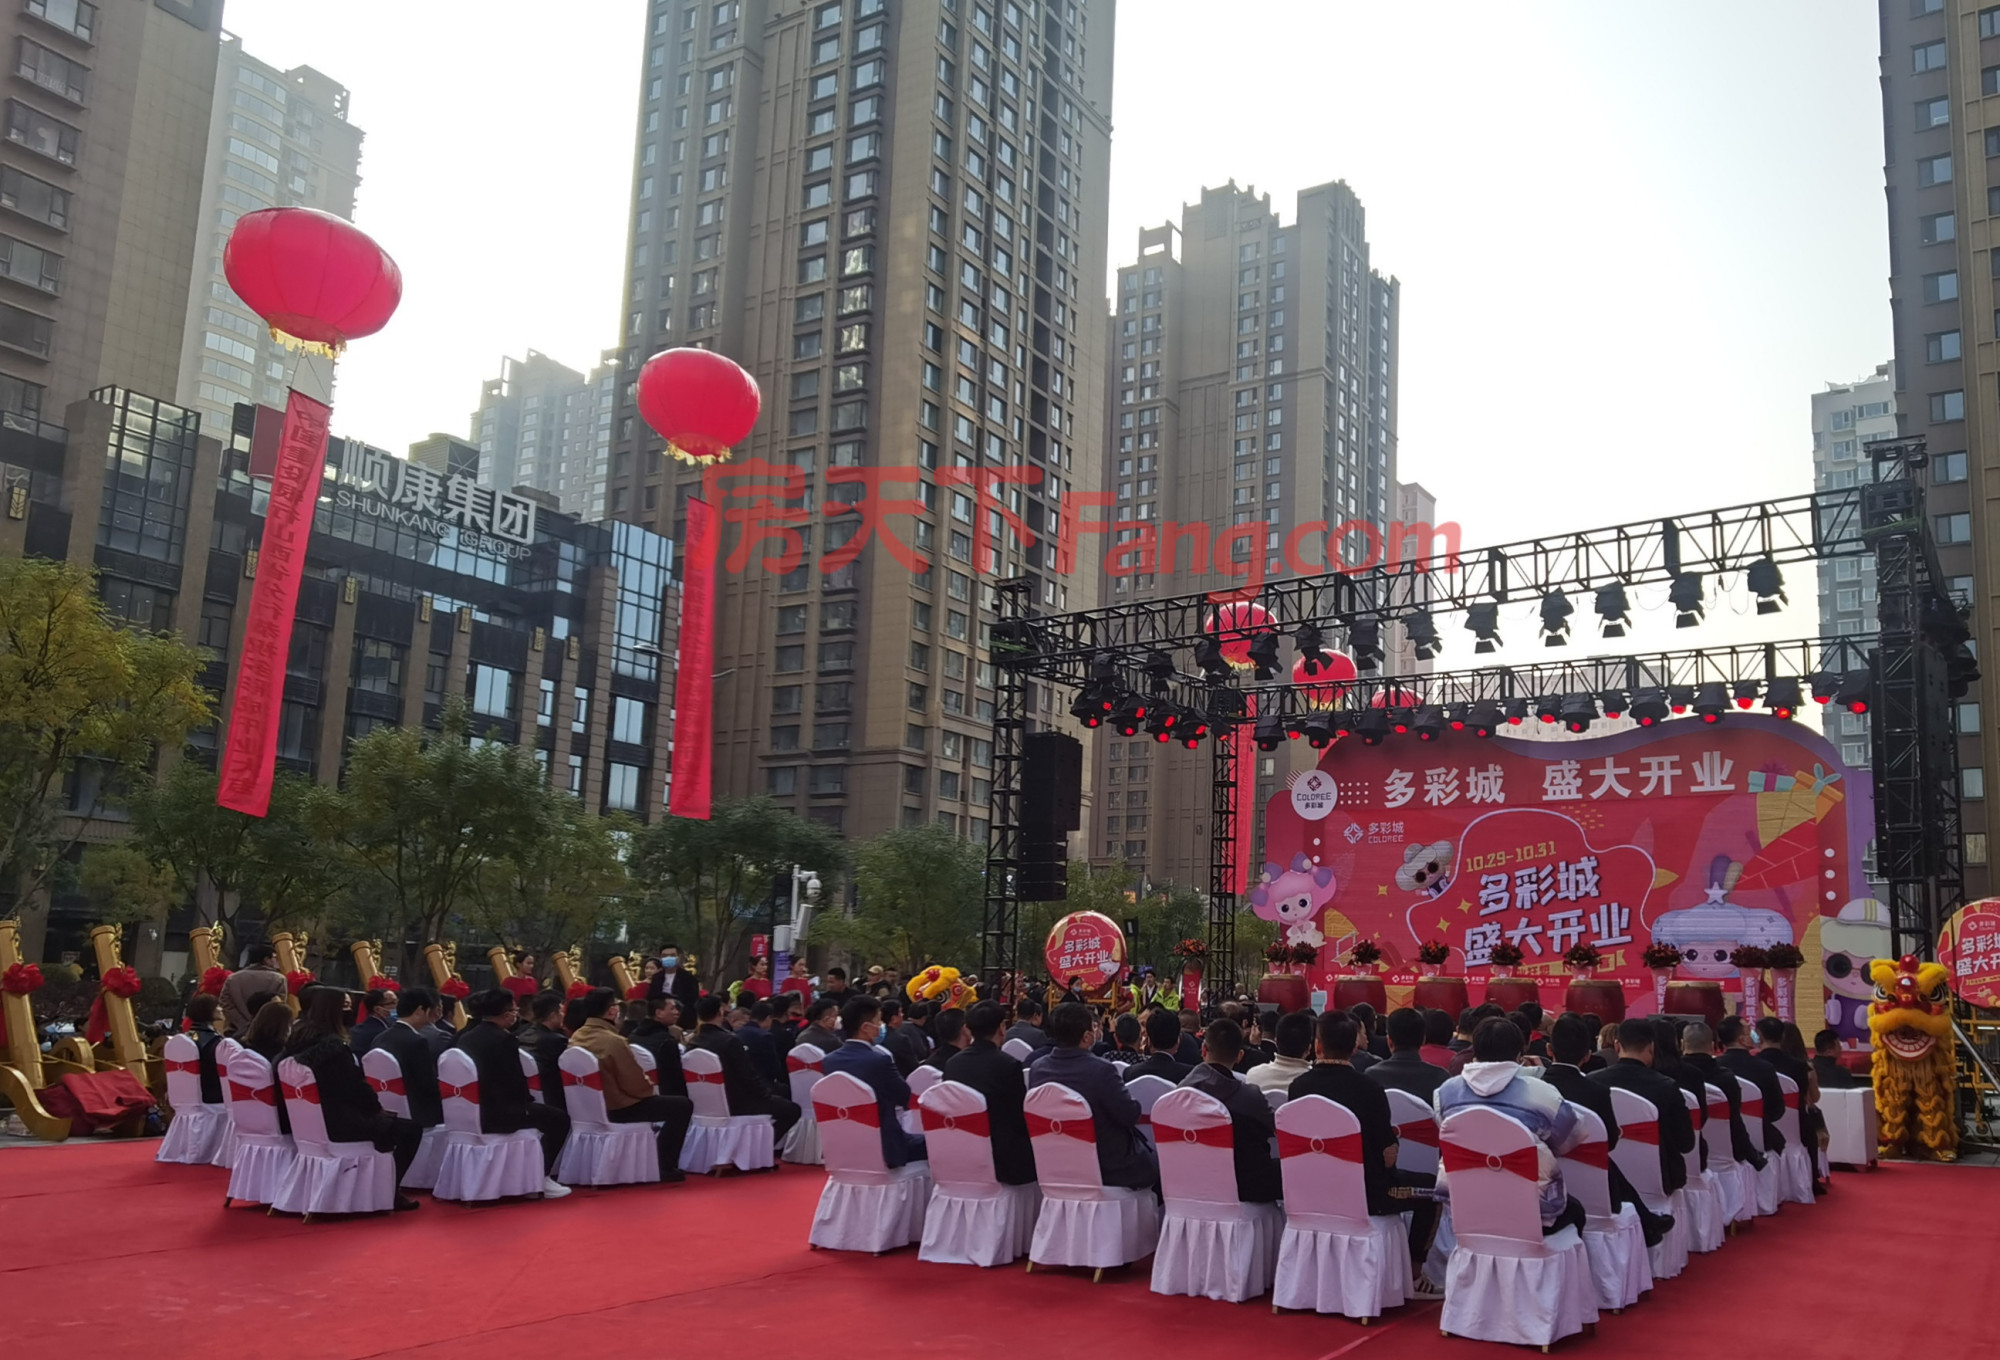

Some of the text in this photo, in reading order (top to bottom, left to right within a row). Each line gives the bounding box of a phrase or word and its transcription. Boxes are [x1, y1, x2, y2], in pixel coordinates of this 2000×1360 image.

[338, 435, 537, 545] 顺康集团
[336, 489, 532, 562] SHUNKANG GROUP
[1384, 751, 1736, 808] 多彩城 盛大开业
[1368, 821, 1405, 835] 多彩城
[1466, 841, 1557, 872] 10.29-10.31
[1478, 856, 1600, 916] 多彩城
[1059, 950, 1109, 969] 盛大开业
[1064, 936, 1101, 954] 多彩城
[1464, 902, 1632, 967] 盛大开业
